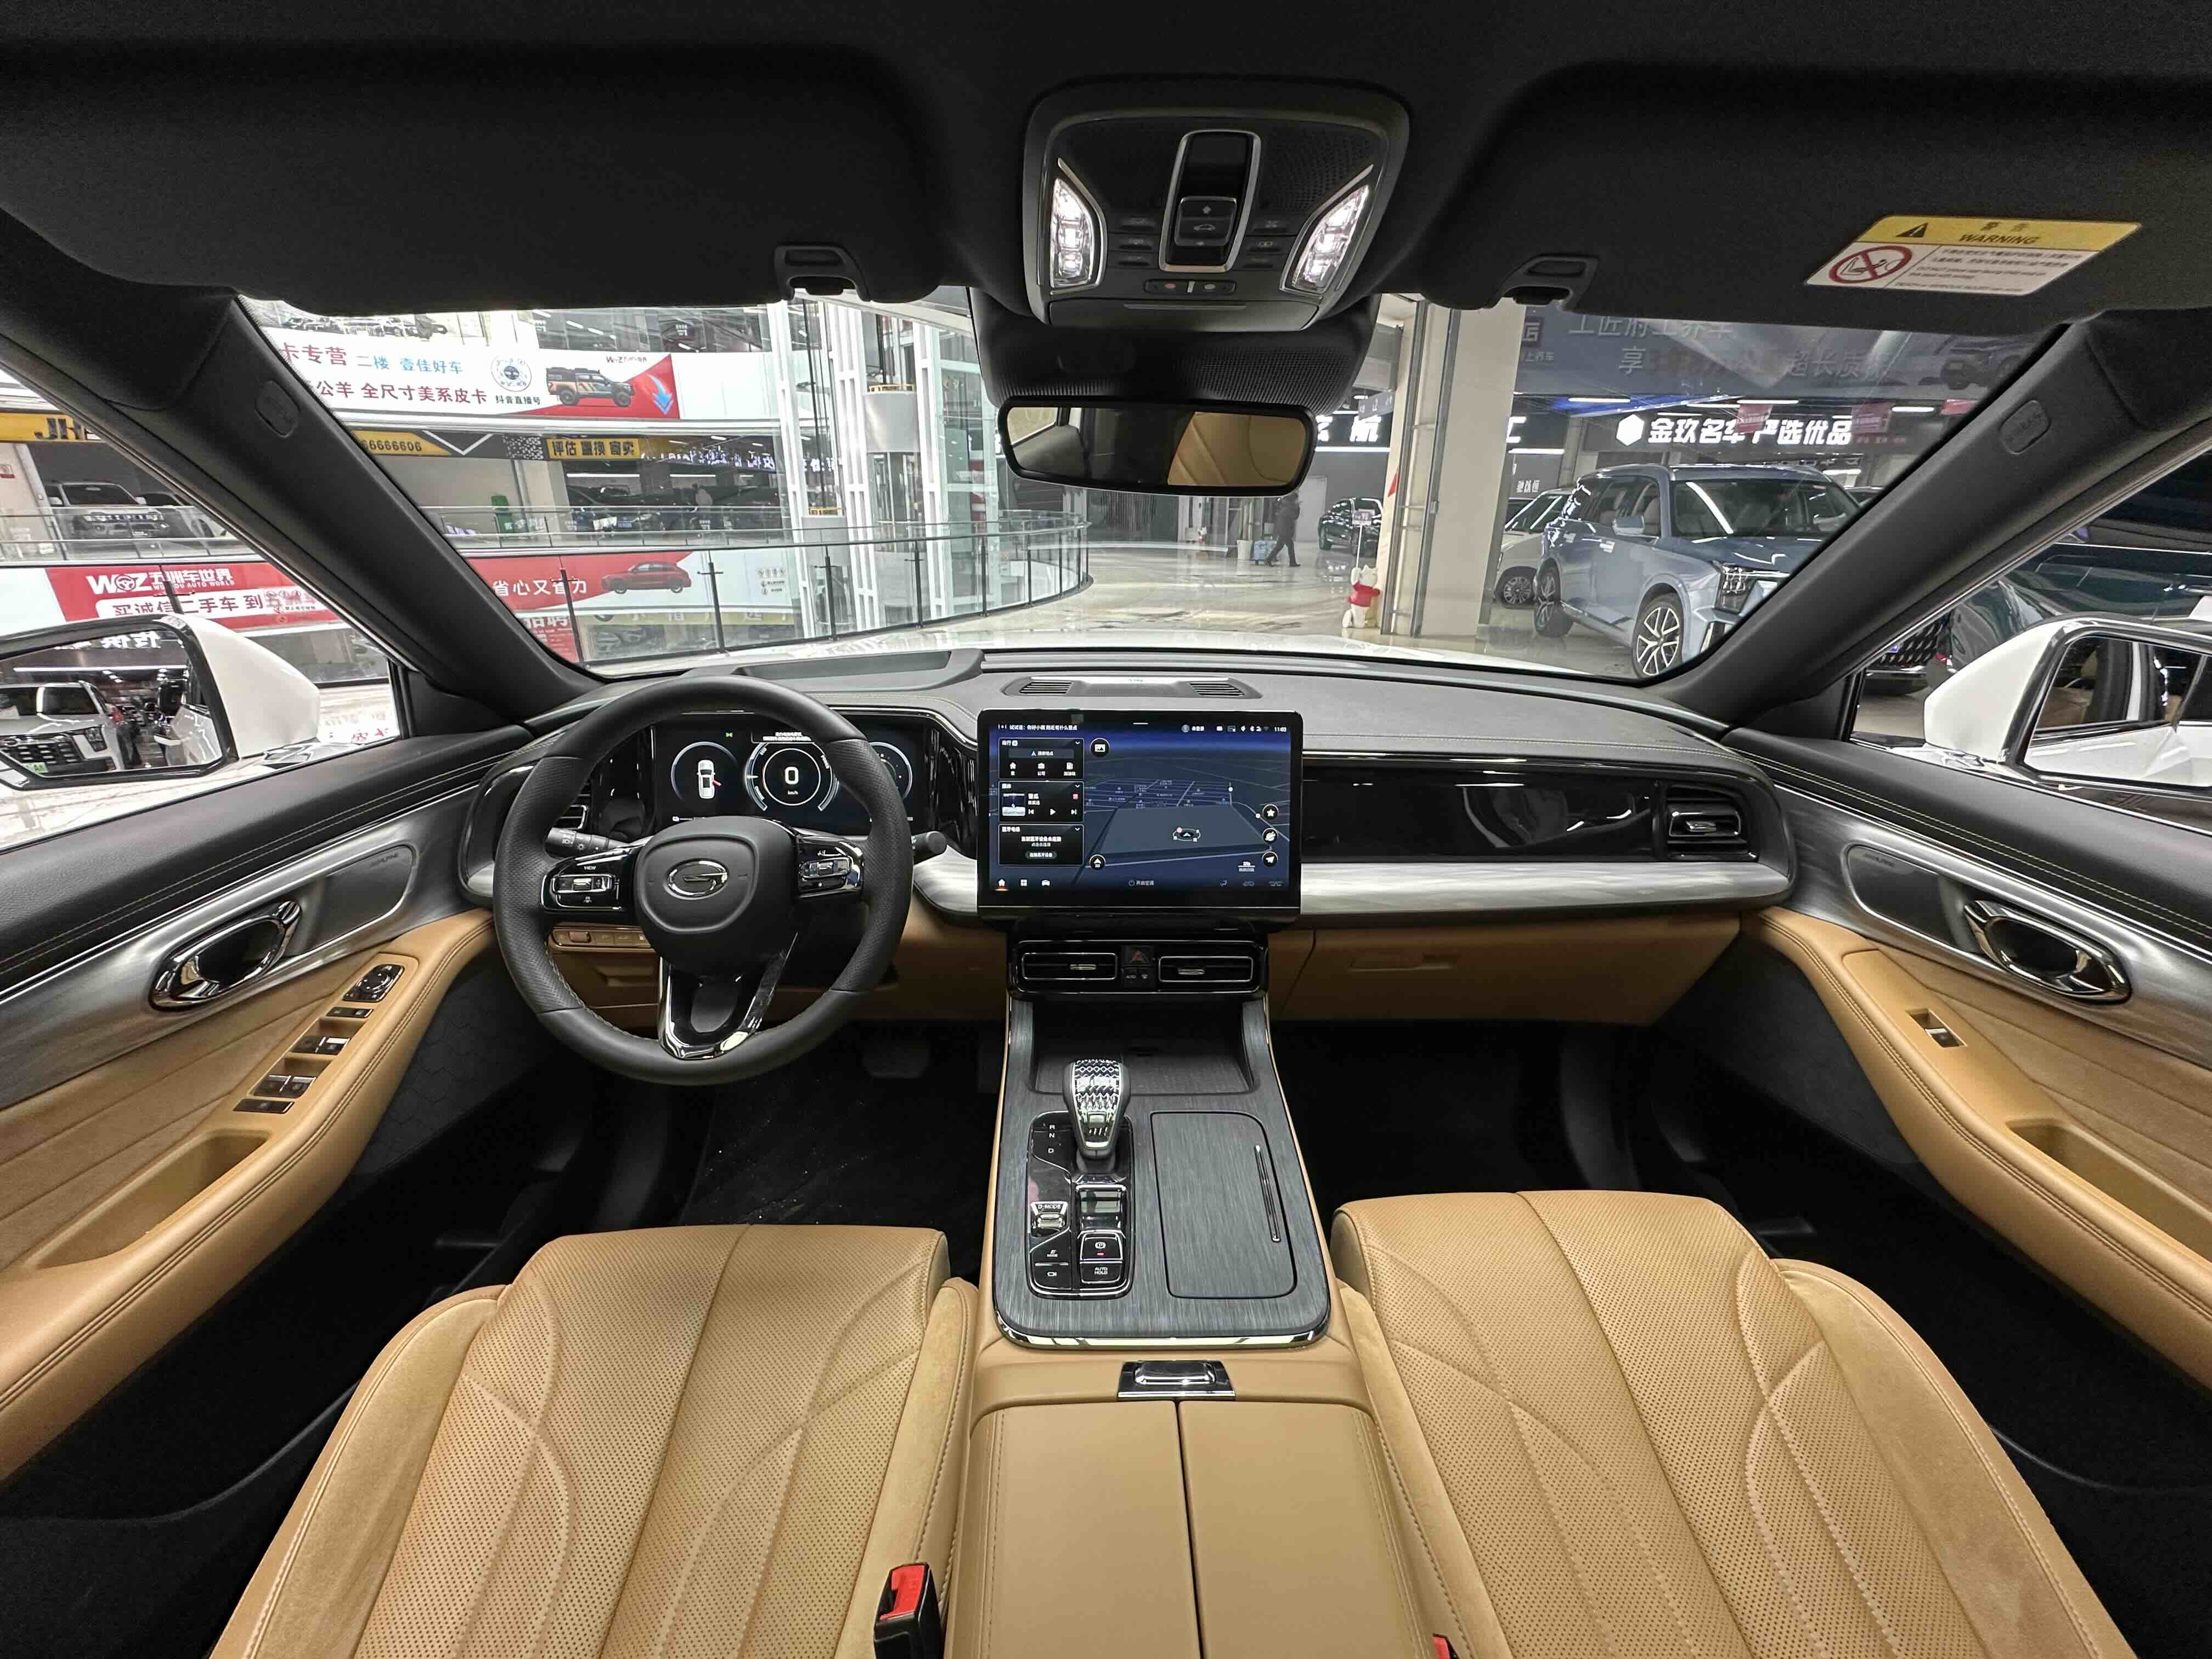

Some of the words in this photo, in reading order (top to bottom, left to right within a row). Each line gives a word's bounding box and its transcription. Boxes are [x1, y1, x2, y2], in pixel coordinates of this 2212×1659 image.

[1959, 233, 2040, 245] WARNING
[1618, 345, 1646, 375] 享
[317, 380, 354, 398] 公羊
[361, 382, 487, 404] 全尺寸美系皮卡
[1647, 417, 1746, 444] 金玖名车
[492, 578, 587, 597] 省心又省力
[243, 594, 263, 610] 到
